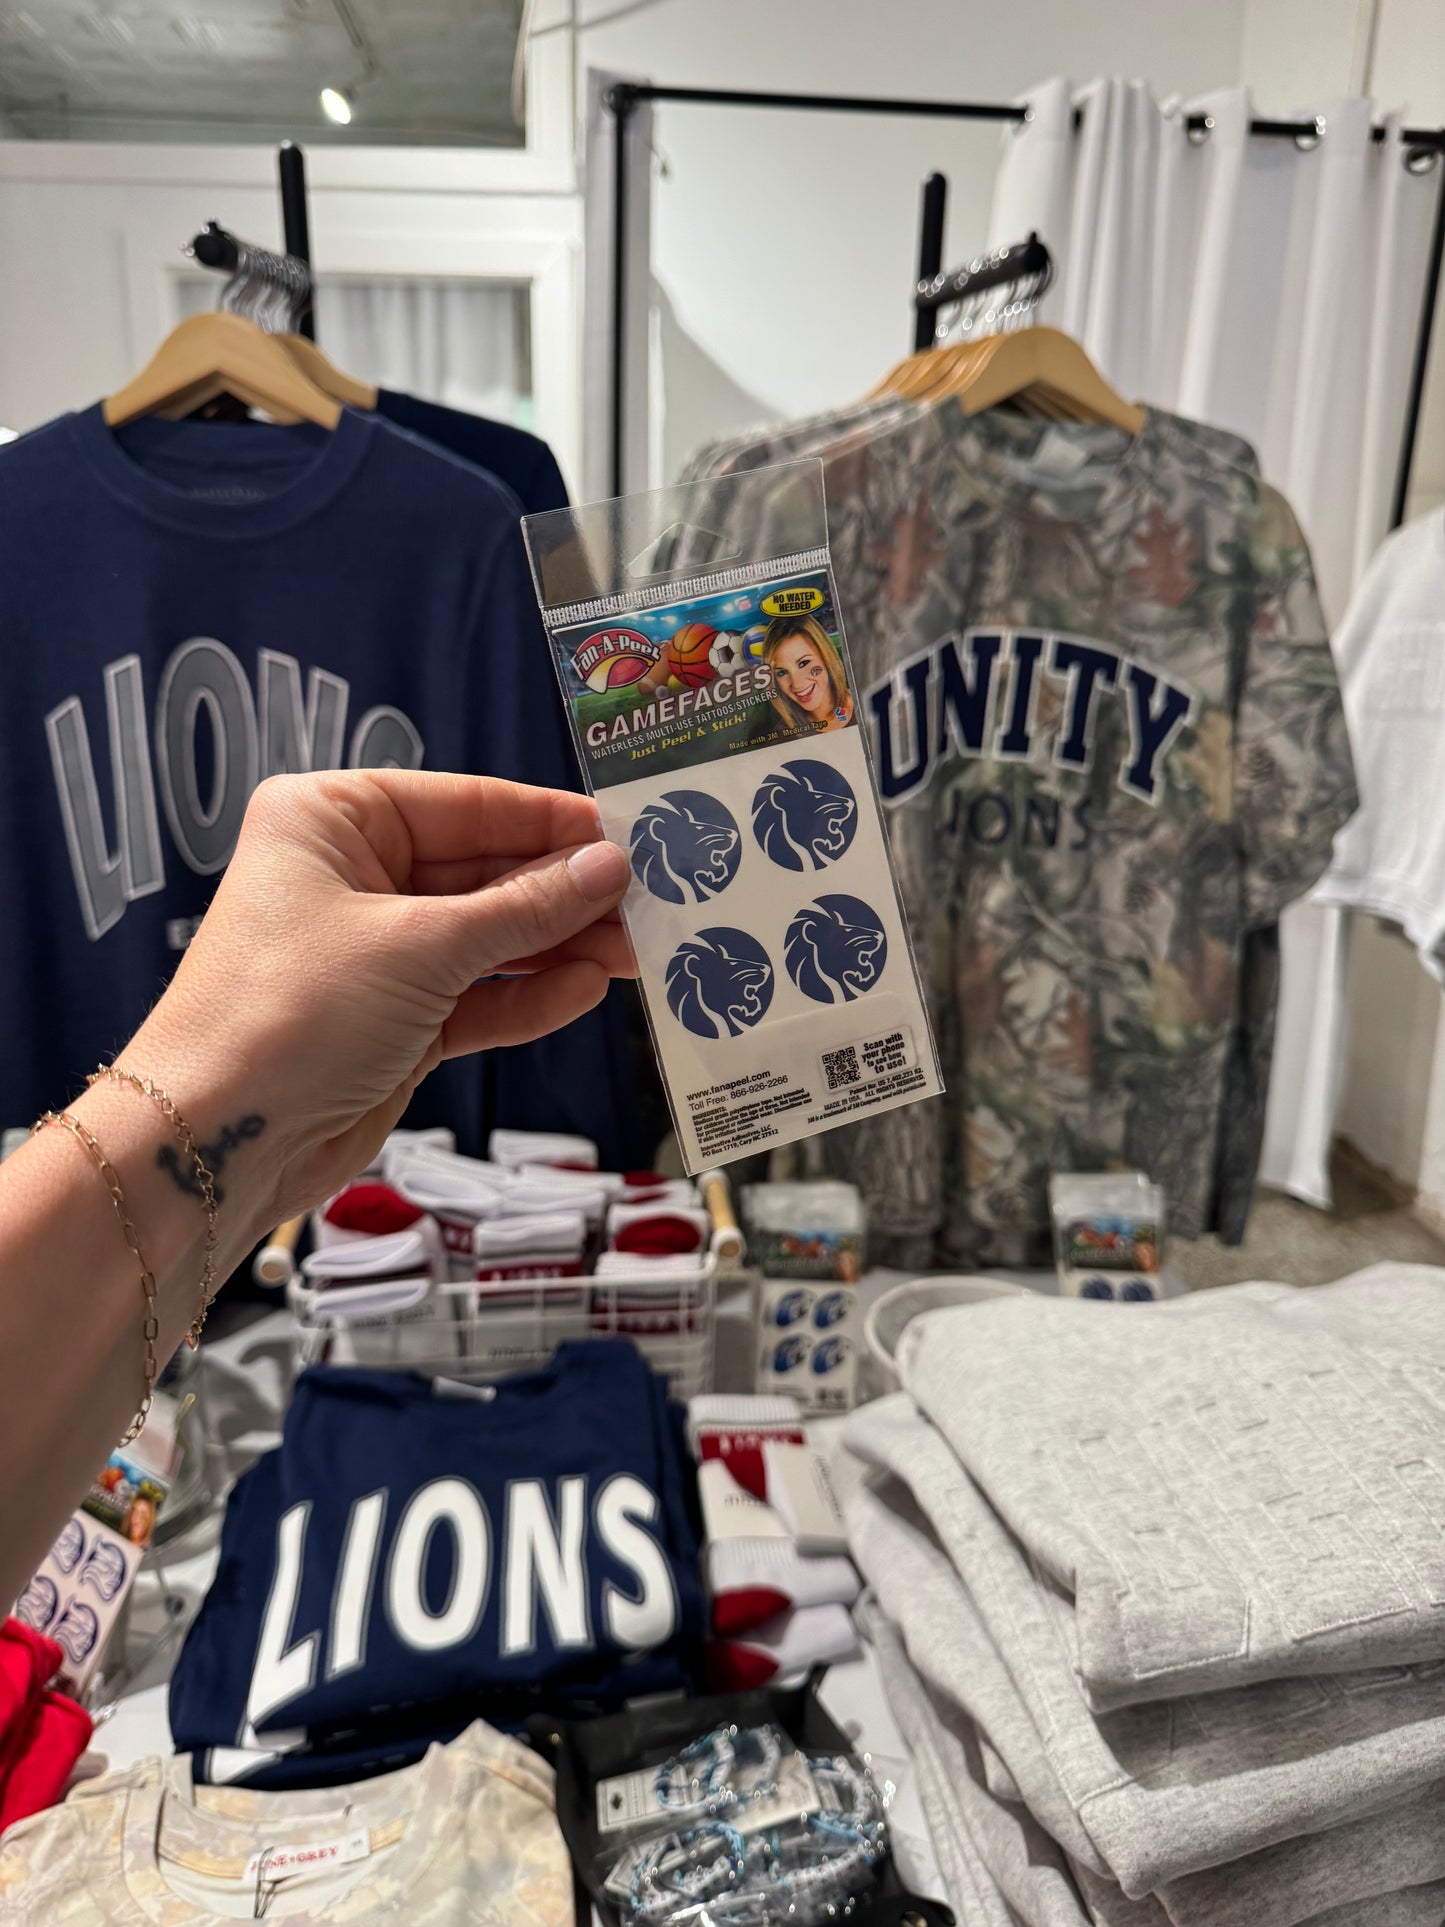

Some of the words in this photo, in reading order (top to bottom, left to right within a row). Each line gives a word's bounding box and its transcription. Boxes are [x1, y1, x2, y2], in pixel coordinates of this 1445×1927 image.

[773, 594, 785, 604] NO
[786, 591, 815, 602] WATER
[779, 601, 811, 613] NEEDED
[586, 664, 773, 748] GAMEFACES
[863, 626, 1197, 808] UNITY
[591, 734, 645, 760] WATERLESS
[646, 718, 694, 741] MULTI-USE
[631, 746, 656, 761] Just
[661, 733, 692, 750] Peel
[696, 727, 706, 738] &
[711, 711, 747, 733] Stick!
[728, 741, 749, 750] Made
[750, 736, 766, 745] with
[767, 731, 779, 741] 3M
[782, 724, 811, 737] Medical
[812, 720, 828, 730] Tape
[45, 635, 425, 942] LION
[861, 1050, 879, 1063] your
[881, 1041, 905, 1055] phone
[863, 1040, 884, 1052] Scan
[885, 1032, 903, 1045] with
[867, 1060, 875, 1068] to
[875, 1056, 887, 1065] see
[888, 1051, 902, 1061] how
[874, 1064, 885, 1074] to
[887, 1055, 907, 1070] use!
[687, 1070, 771, 1101] www.fanapeel.com
[689, 1101, 704, 1112] Toll
[706, 1095, 729, 1107] Free:
[730, 1075, 789, 1099] 866-926-2266
[864, 1090, 875, 1098] ALL
[761, 1124, 771, 1134] LLC
[702, 1150, 711, 1158] PO
[711, 1146, 722, 1155] Box
[740, 1137, 752, 1147] Cary
[752, 1134, 761, 1142] NC
[244, 1470, 678, 1730] LIONS
